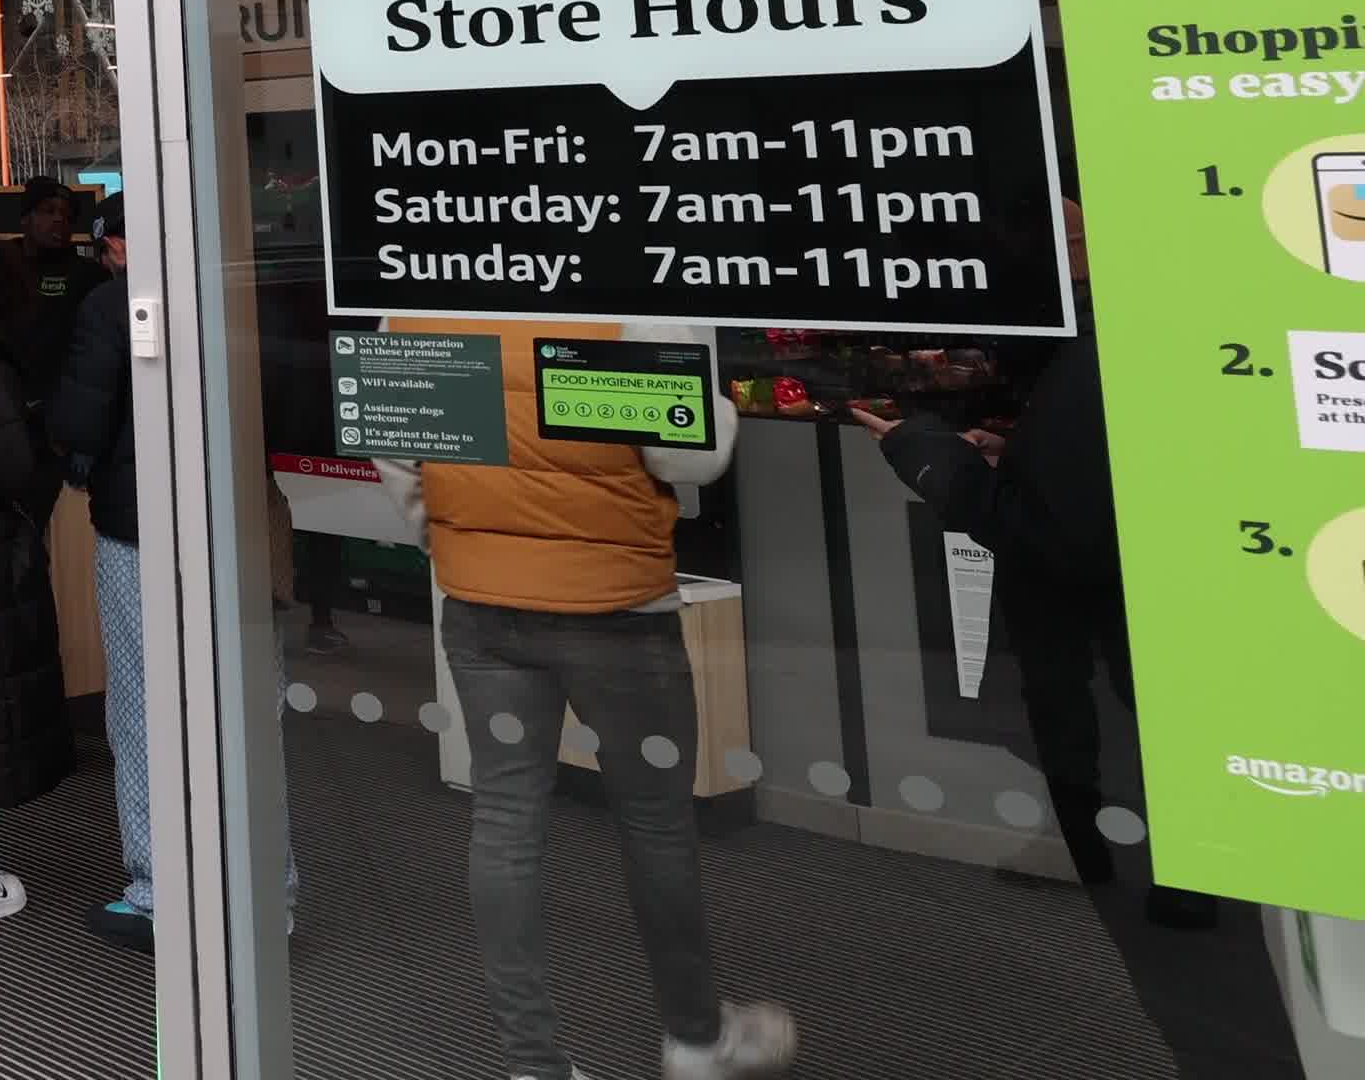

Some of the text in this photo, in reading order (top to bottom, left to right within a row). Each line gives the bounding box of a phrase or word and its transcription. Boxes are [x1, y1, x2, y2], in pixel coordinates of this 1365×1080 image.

[1148, 14, 1365, 62] Shoppi
[1151, 70, 1365, 105] as easy
[372, 120, 974, 169] Mon-Fri: 7am-11pm
[1197, 164, 1243, 197] 1.
[374, 184, 981, 234] Saturday: 7am-11pm
[378, 244, 988, 299] Sunday: 7am-11pm
[359, 337, 464, 349] CCTV is in operation
[375, 347, 401, 356] these
[404, 348, 451, 358] premises
[1219, 343, 1274, 377] 2.
[388, 379, 435, 390] available
[550, 374, 693, 391] FOOD HYGIENE RATING
[1316, 393, 1365, 407] Pres
[364, 403, 444, 416] Assistance dogs
[673, 407, 689, 425] 5
[1317, 412, 1339, 423] at
[364, 413, 409, 423] welcome
[365, 428, 473, 442] It's against the law to
[366, 438, 461, 451] smoke in our store
[321, 463, 378, 478] Deliveries
[1239, 520, 1294, 557] 3.
